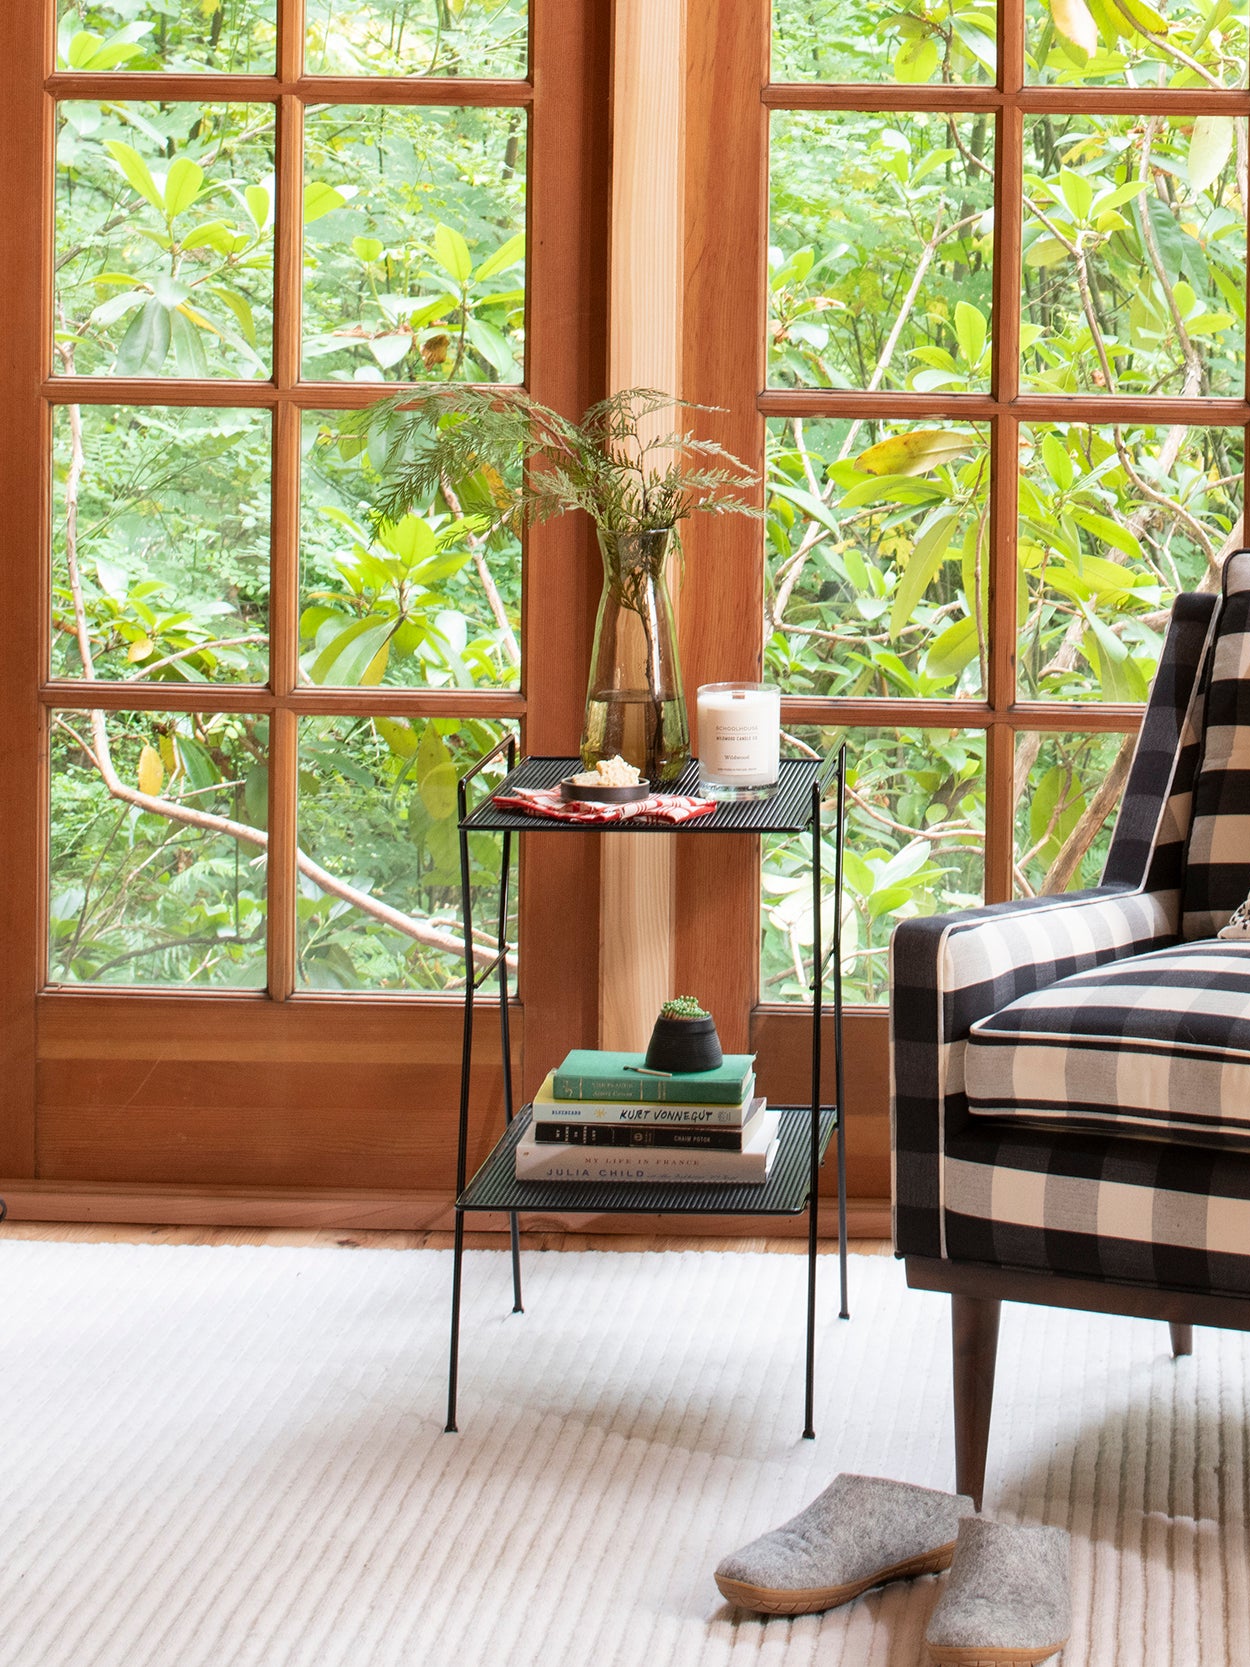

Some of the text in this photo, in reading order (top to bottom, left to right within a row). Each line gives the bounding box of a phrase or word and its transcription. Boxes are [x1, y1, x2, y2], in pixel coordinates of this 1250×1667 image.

[619, 1109, 713, 1123] KURT VONNEGUT
[546, 1168, 590, 1176] JULIA
[598, 1169, 644, 1177] CHILD
